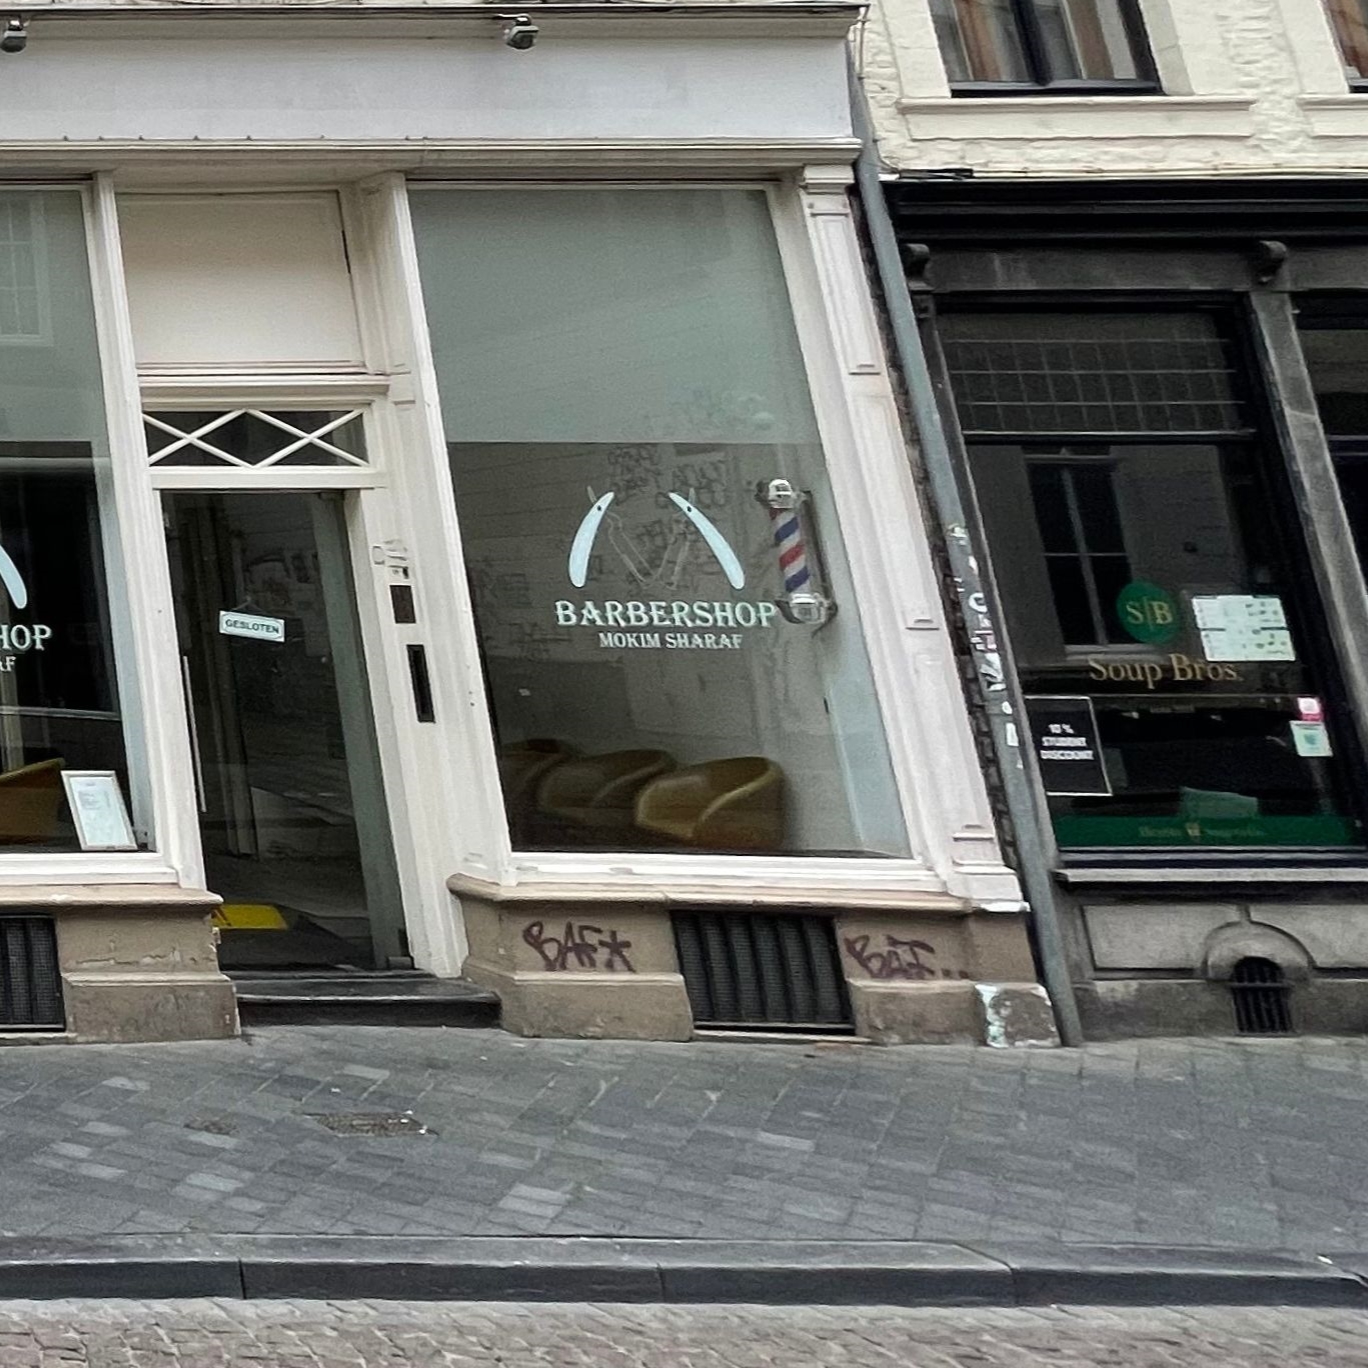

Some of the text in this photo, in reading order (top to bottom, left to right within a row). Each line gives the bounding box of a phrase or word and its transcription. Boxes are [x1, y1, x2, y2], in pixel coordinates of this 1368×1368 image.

[555, 600, 776, 628] BARBERSHOP
[225, 618, 279, 634] GESLOTEN
[599, 632, 743, 649] MOKIM SHARAF
[1088, 653, 1163, 689] Soup
